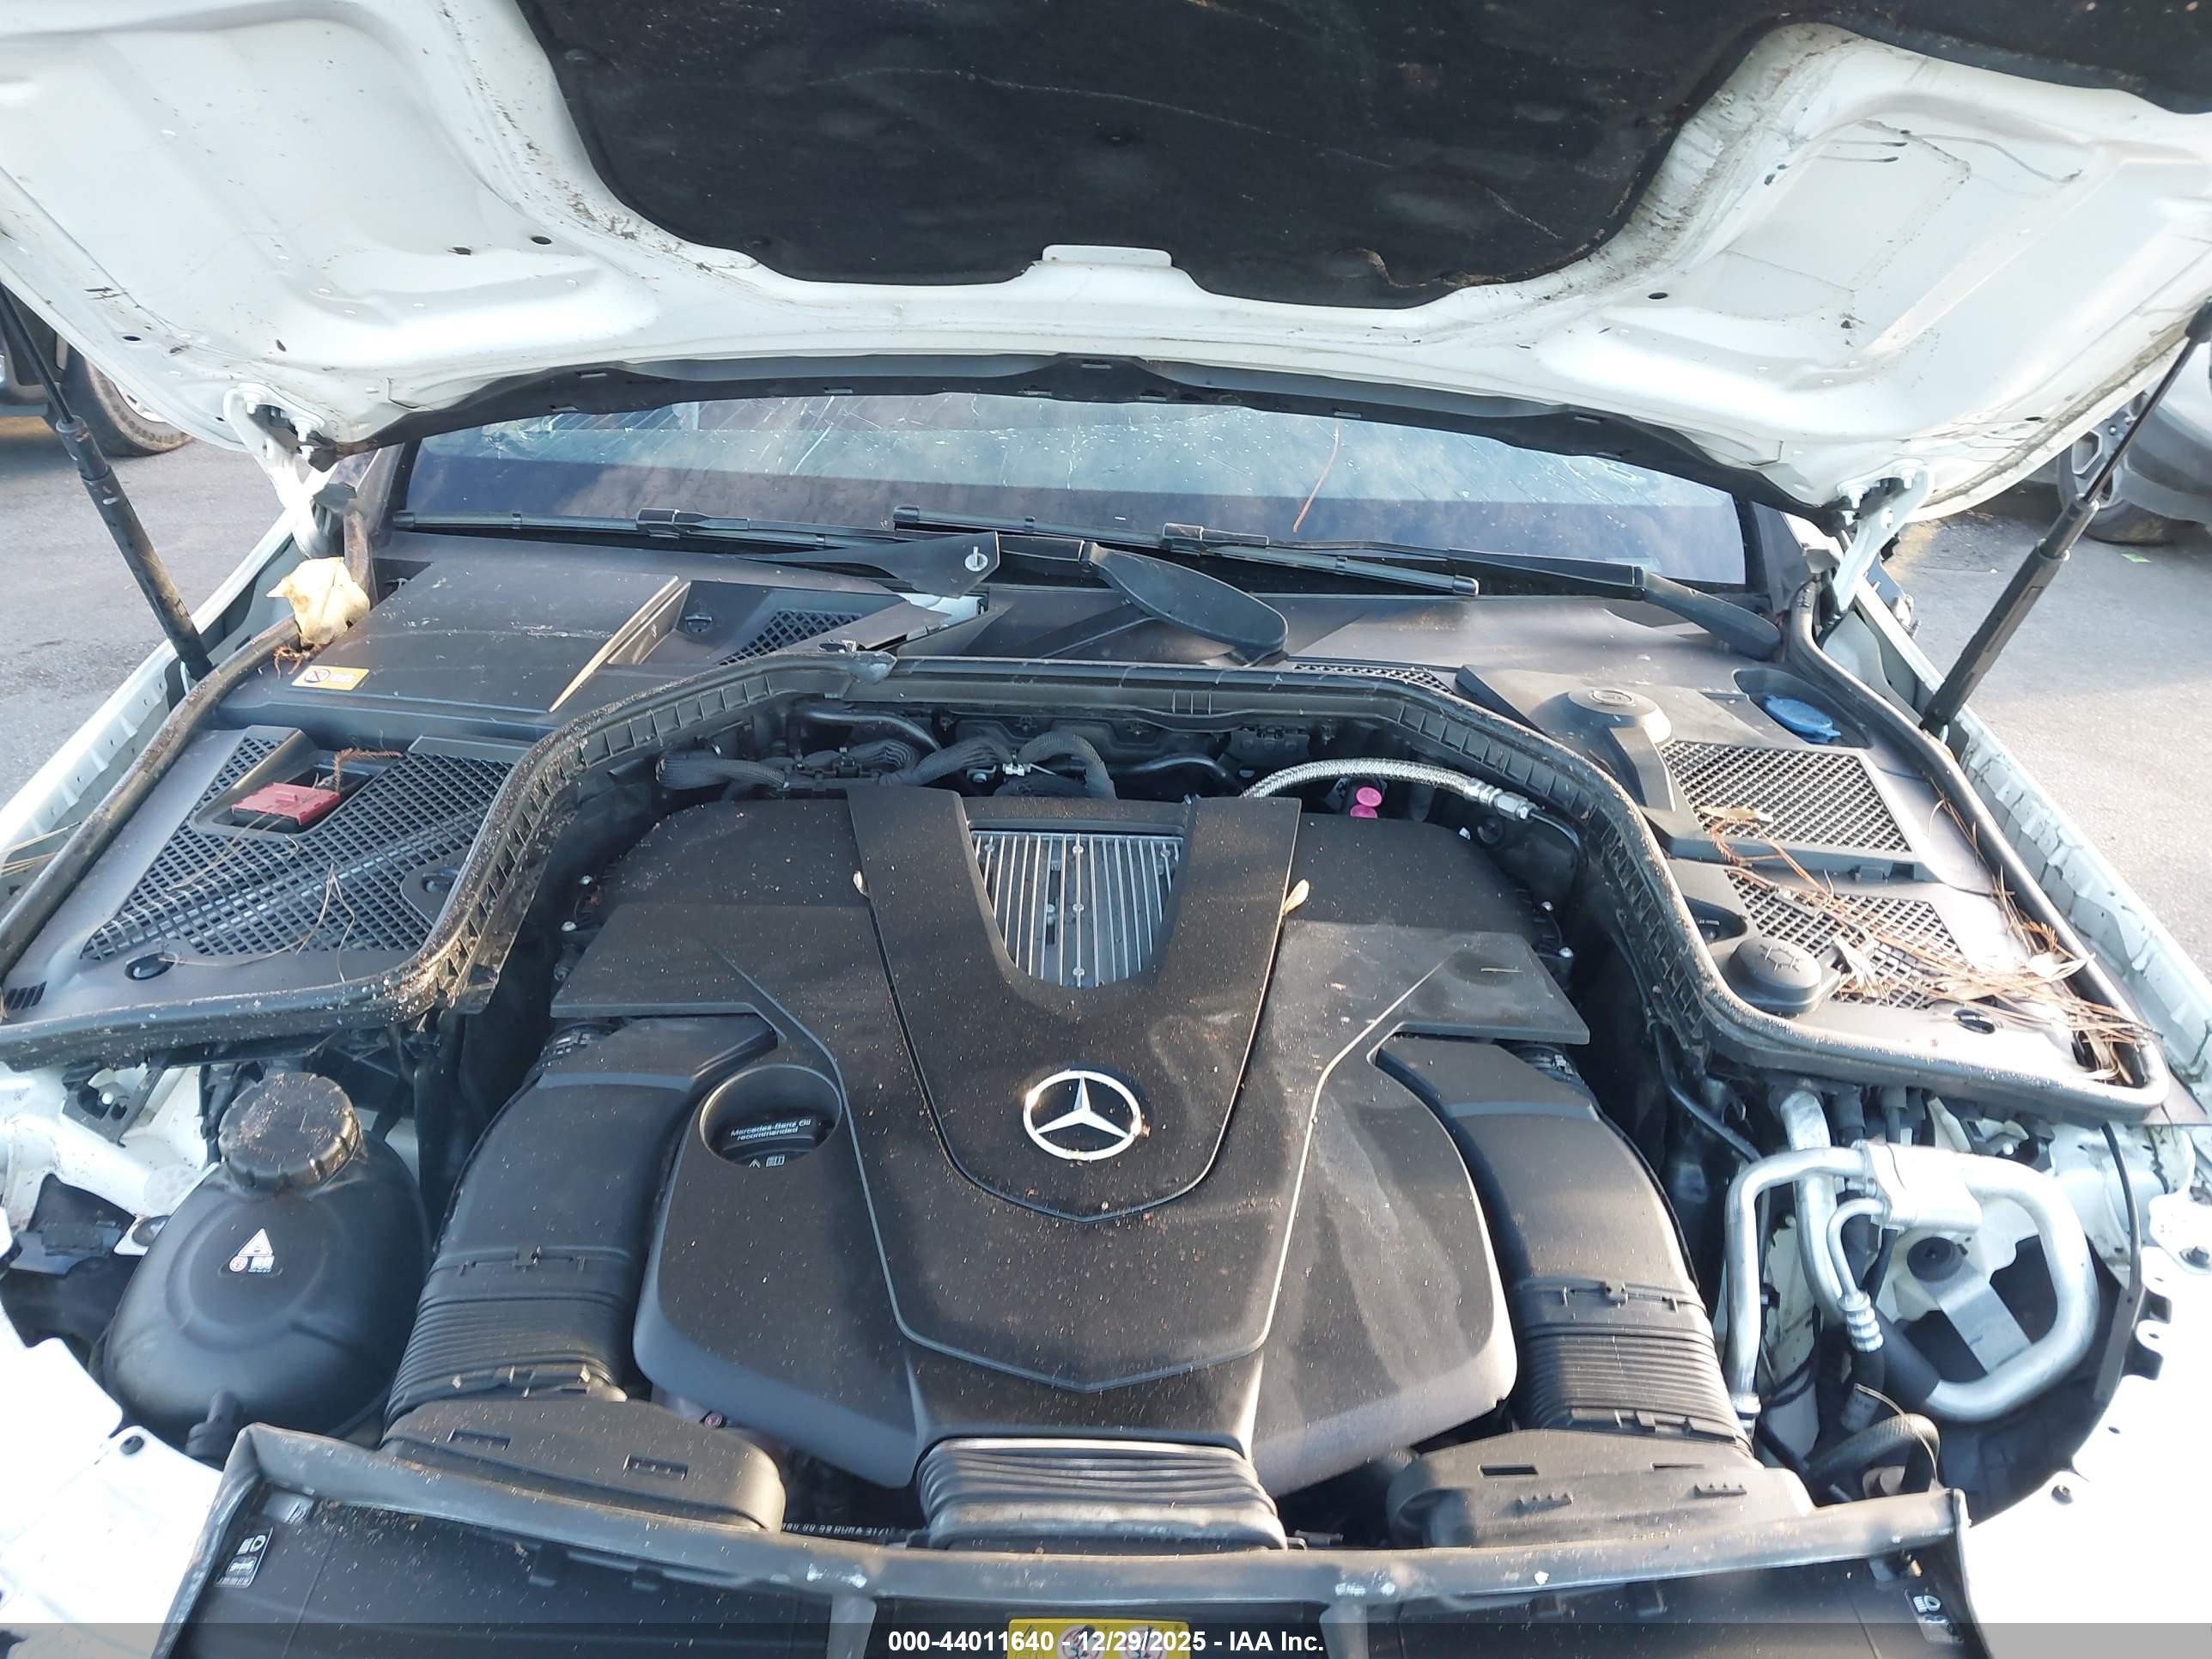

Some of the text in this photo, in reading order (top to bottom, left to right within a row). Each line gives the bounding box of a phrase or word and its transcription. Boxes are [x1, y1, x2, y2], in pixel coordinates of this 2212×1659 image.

[731, 1118, 811, 1137] Mercedes-Benz Oil
[737, 1126, 799, 1141] recommended
